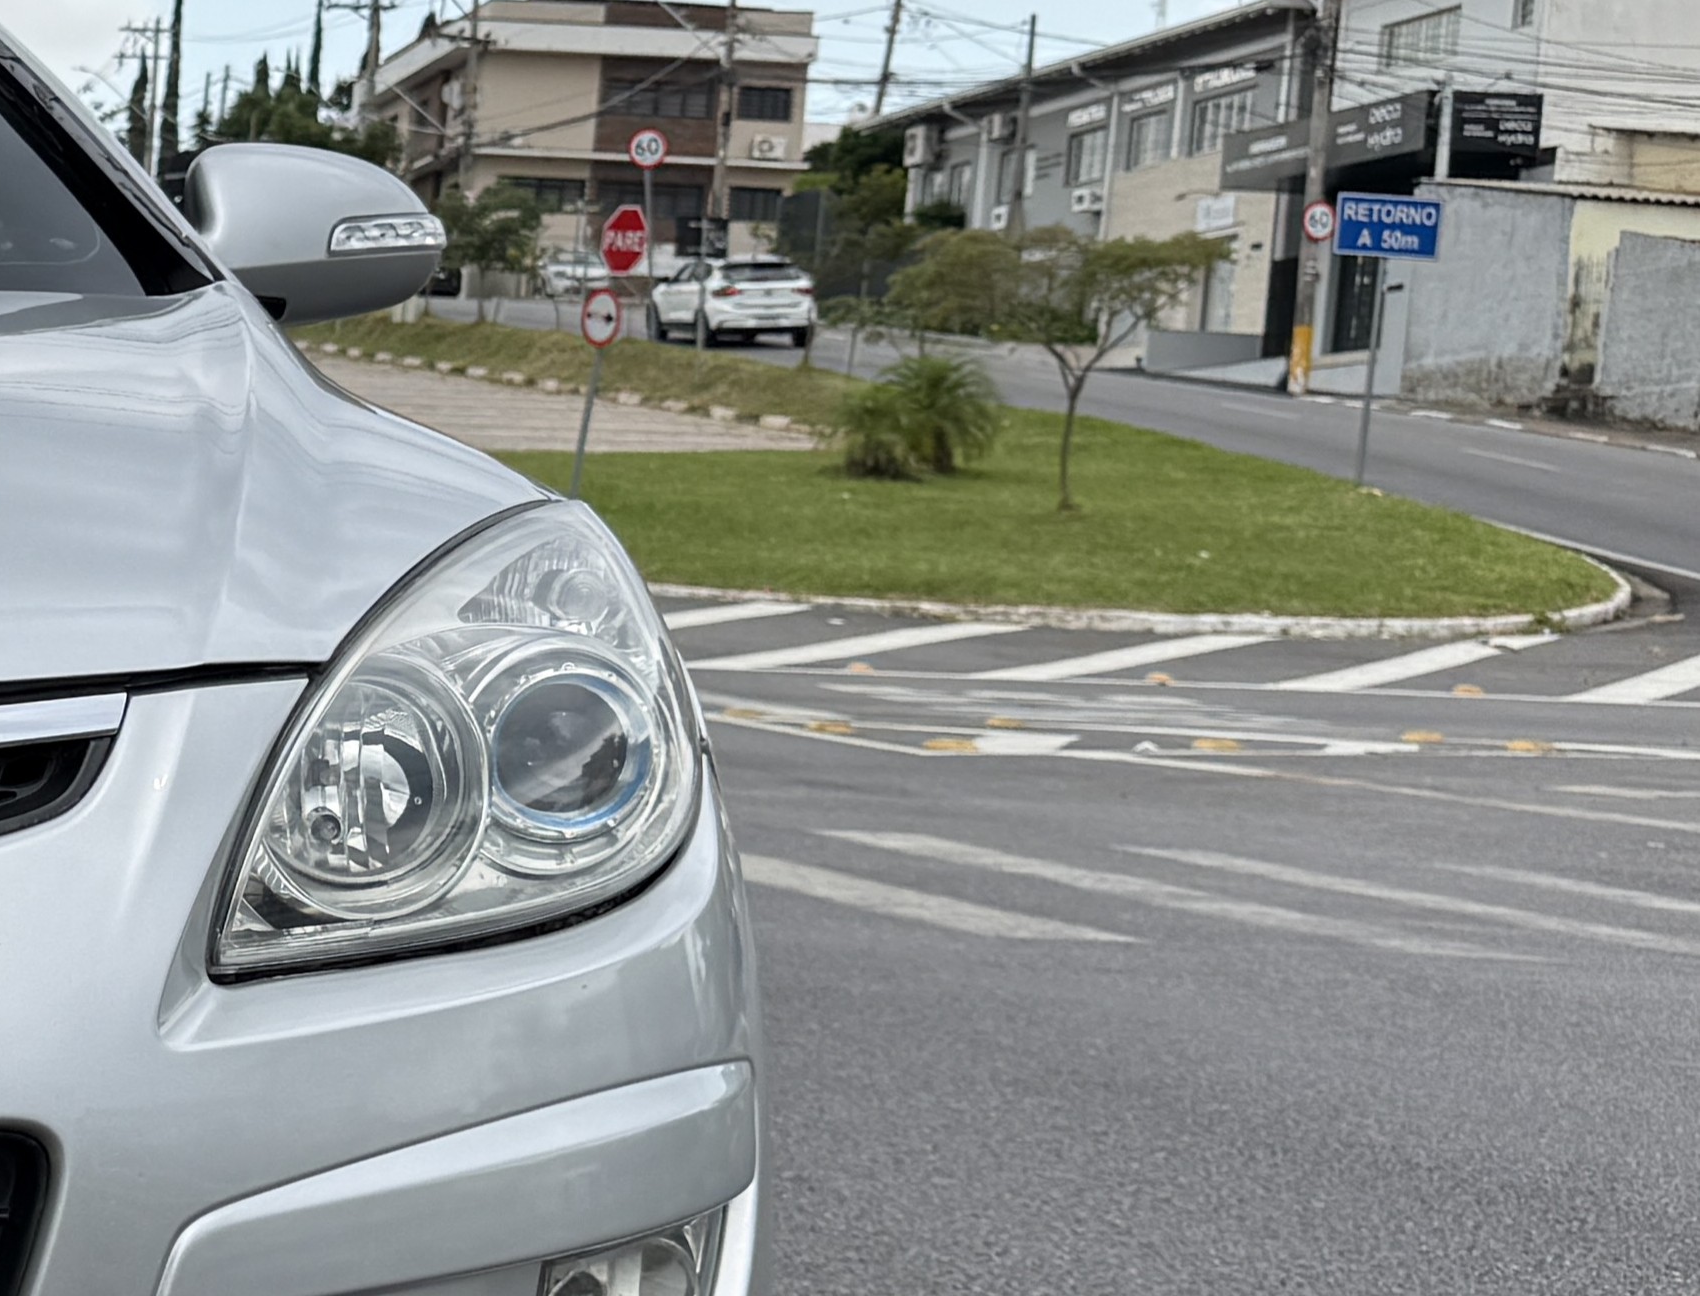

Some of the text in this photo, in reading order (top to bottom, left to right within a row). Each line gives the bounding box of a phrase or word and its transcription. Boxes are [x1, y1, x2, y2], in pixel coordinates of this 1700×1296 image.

[634, 137, 660, 157] 60
[1343, 200, 1437, 227] RETORNO
[605, 229, 645, 252] PARE
[1356, 227, 1420, 251] A 50m
